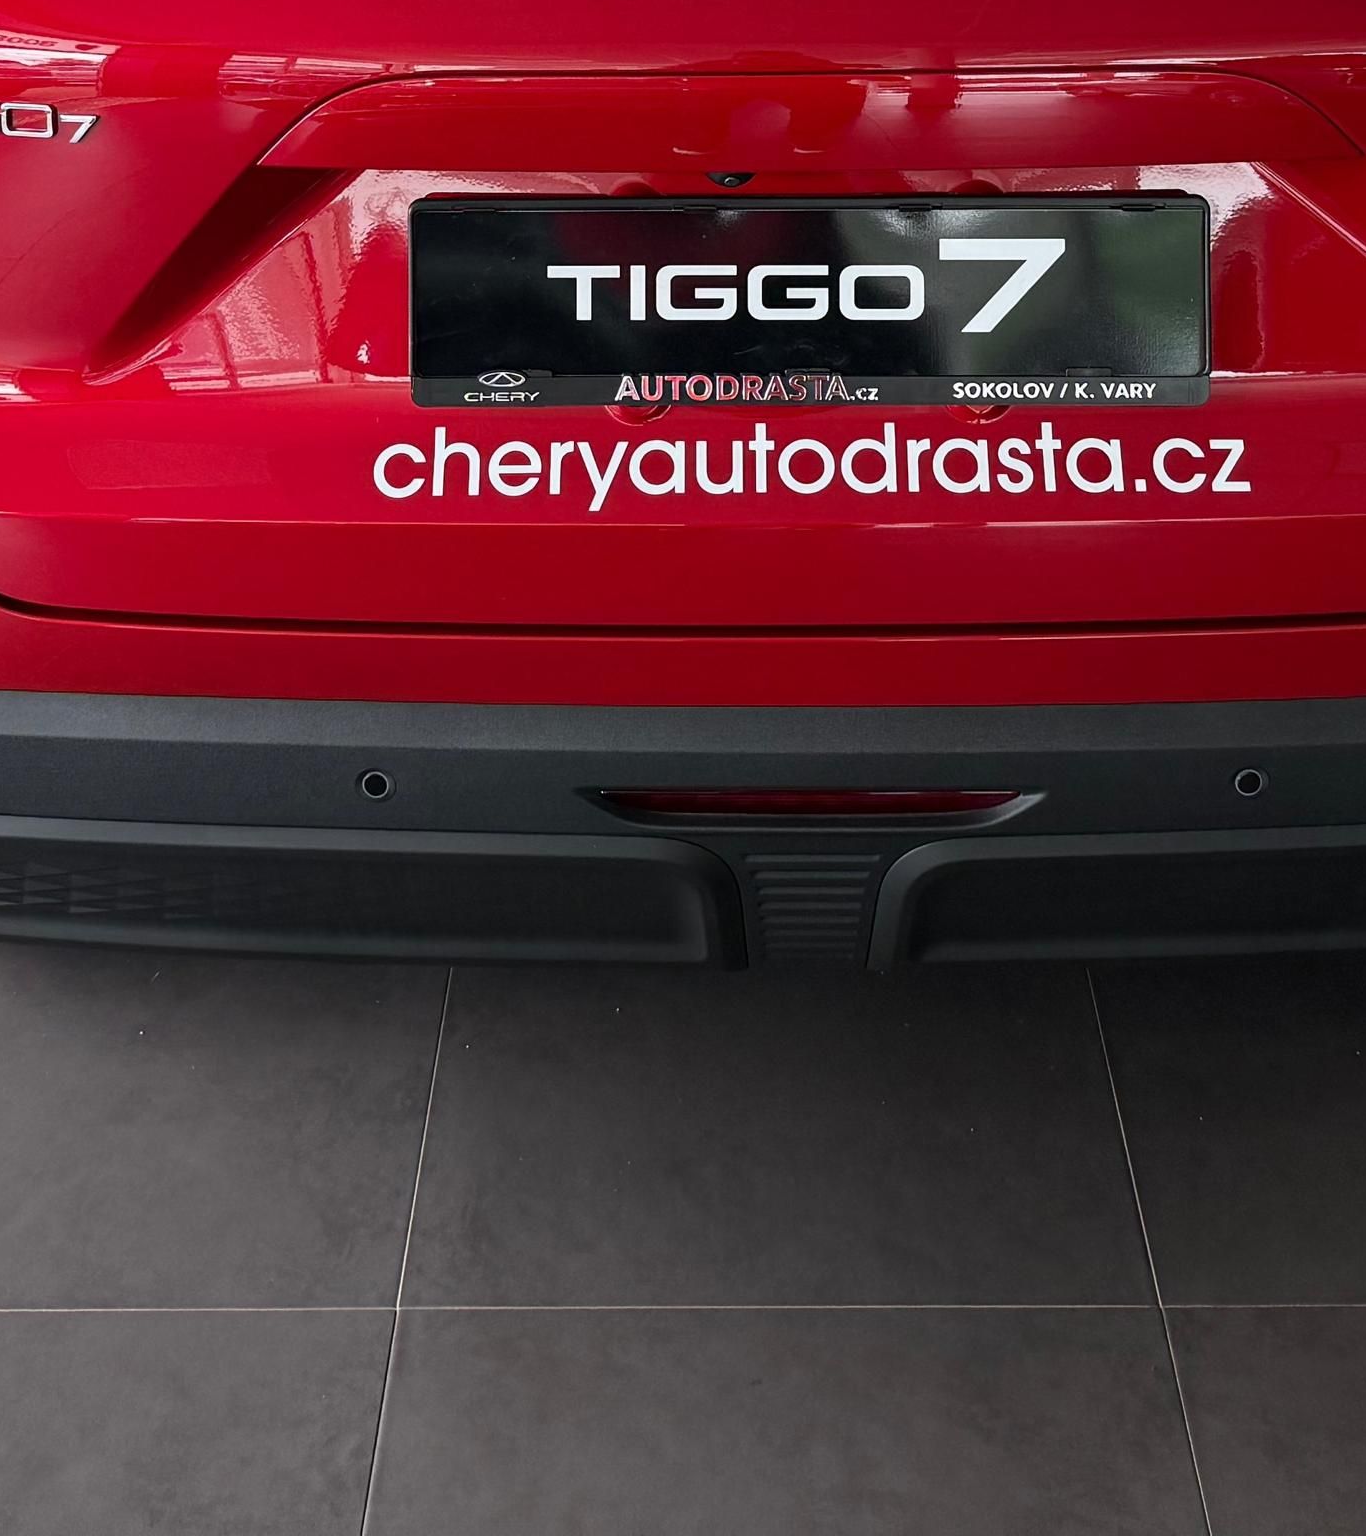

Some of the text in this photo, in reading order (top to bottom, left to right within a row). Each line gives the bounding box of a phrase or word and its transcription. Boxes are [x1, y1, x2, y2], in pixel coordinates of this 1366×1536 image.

[464, 391, 540, 402] CHERY
[952, 382, 1056, 399] SOKOLOV
[1075, 382, 1095, 399] K.
[1100, 382, 1157, 399] VARY
[372, 420, 1251, 511] cheryautodrasta.cz
